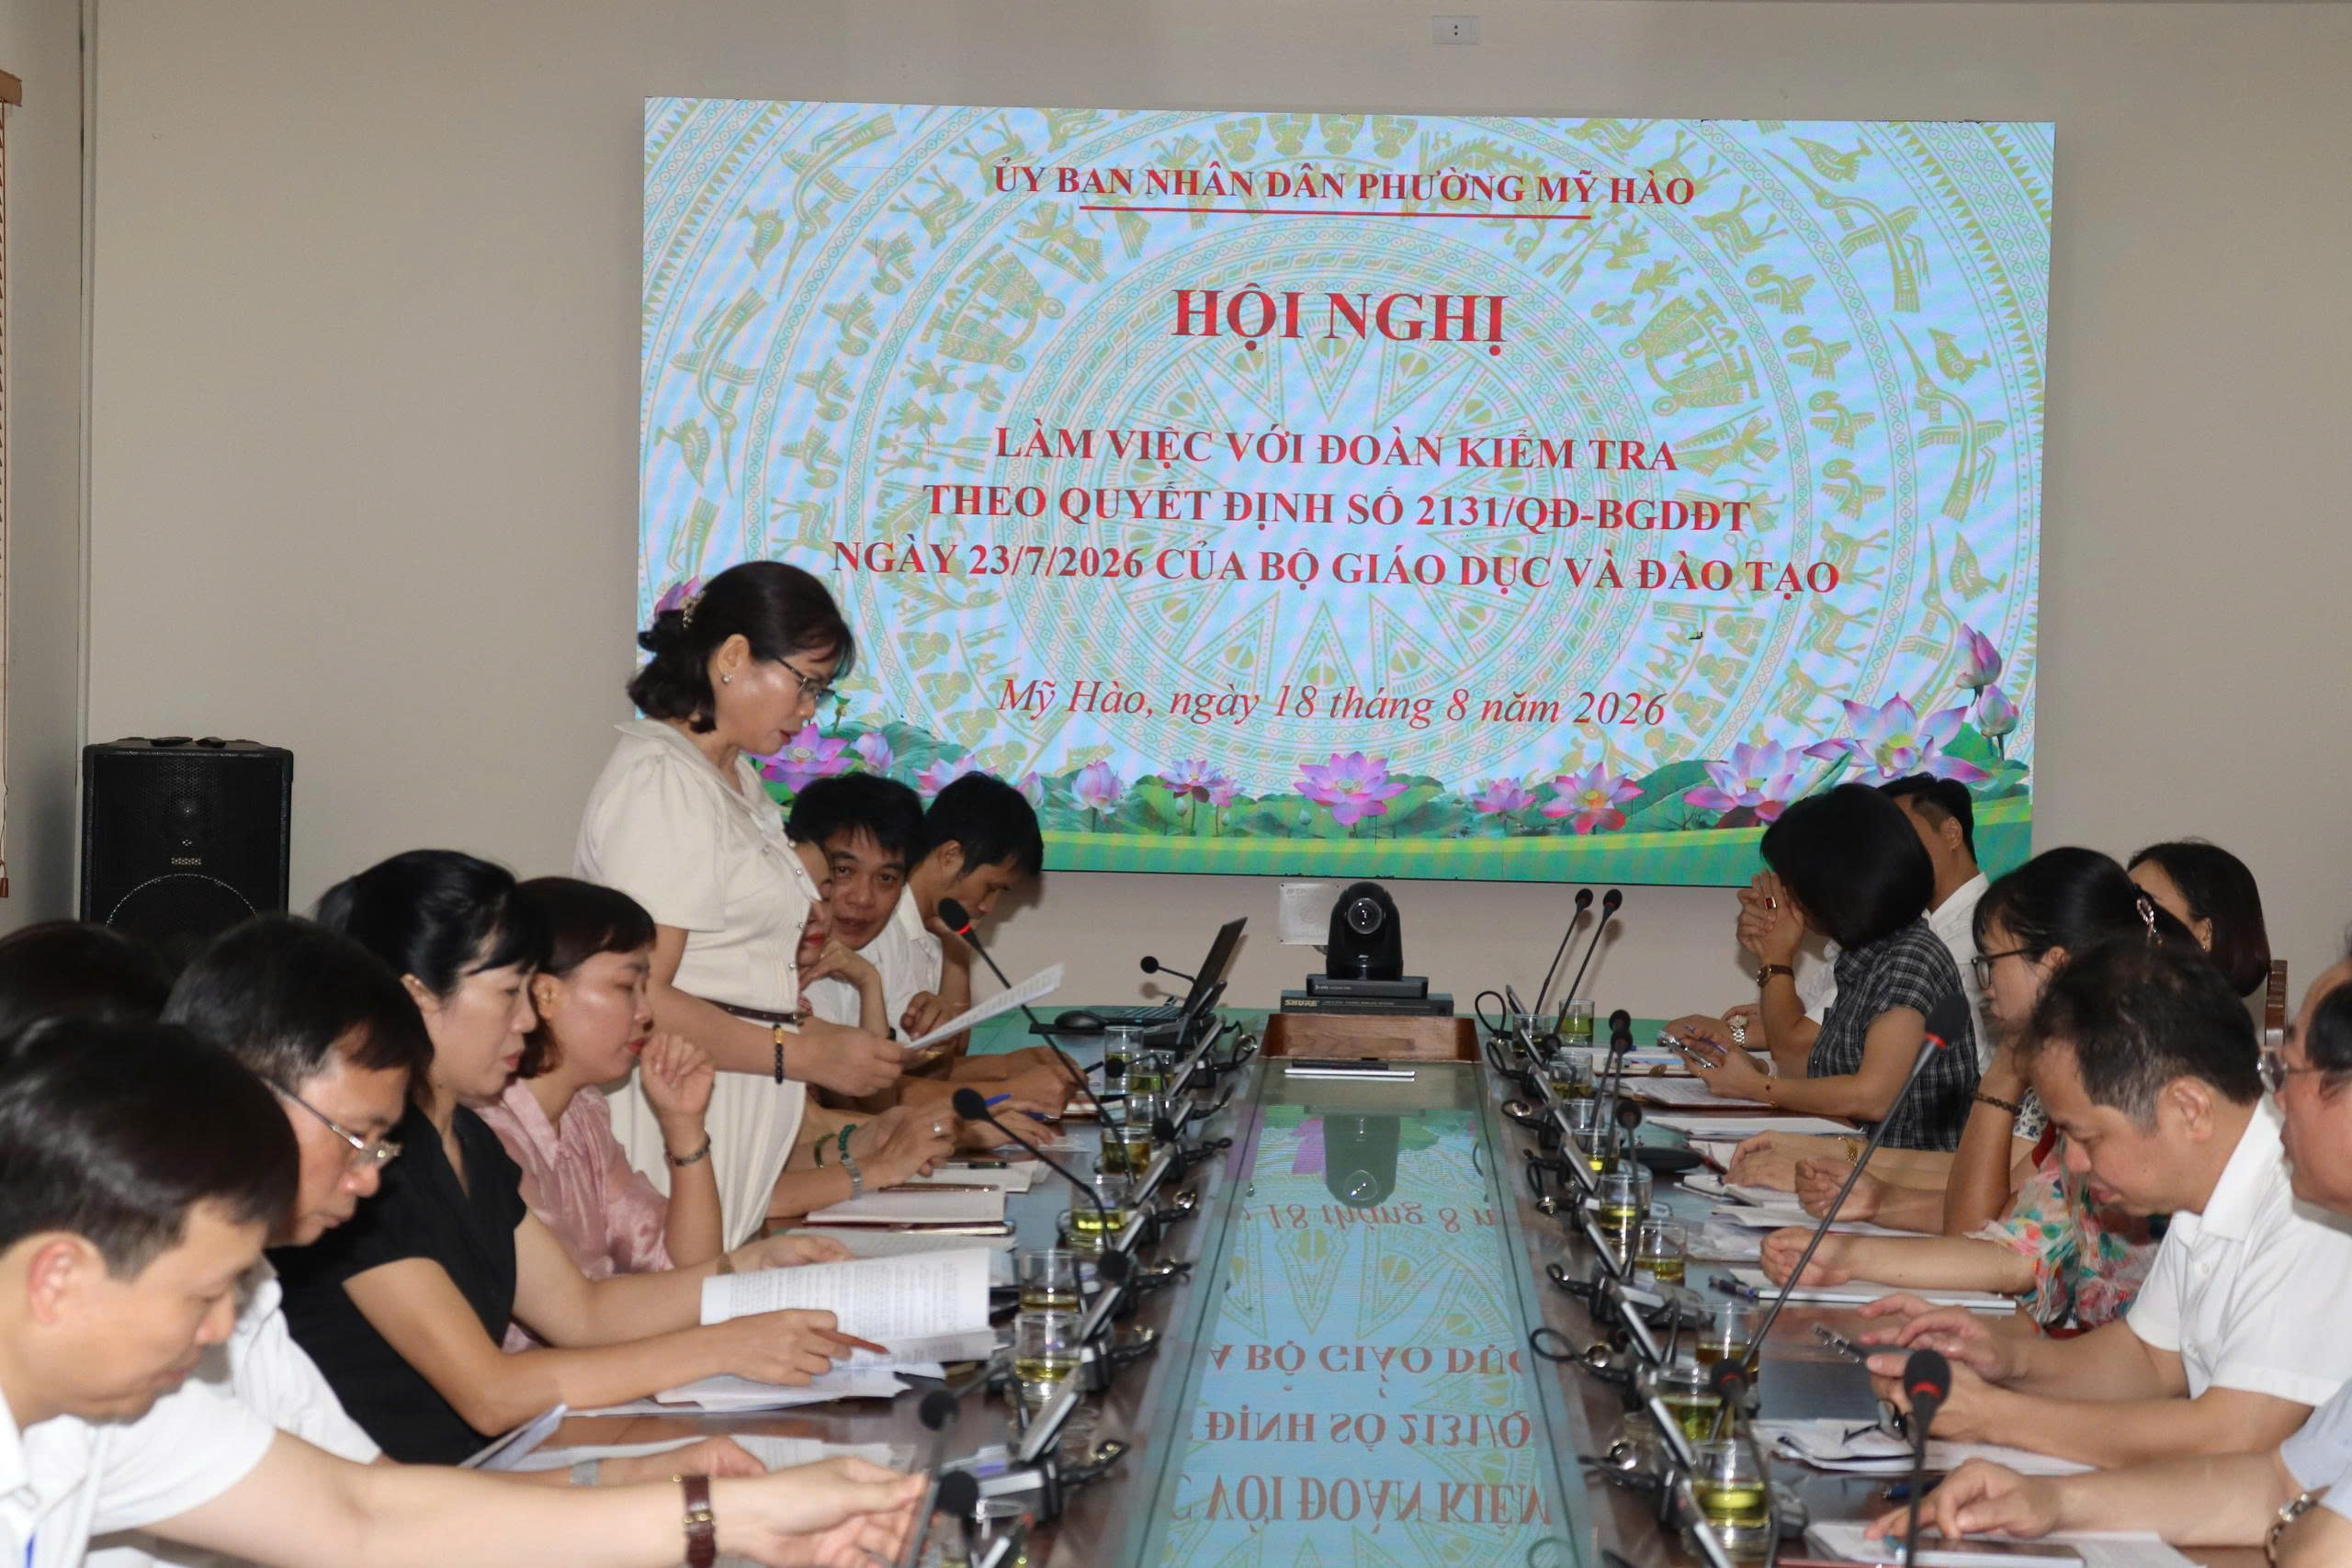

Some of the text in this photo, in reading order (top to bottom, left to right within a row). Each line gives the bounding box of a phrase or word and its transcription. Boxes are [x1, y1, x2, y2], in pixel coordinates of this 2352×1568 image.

[993, 156, 1695, 206] ỦY BAN NHÂN DÂN PHƯỜNG MỸ HÀO
[1172, 283, 1507, 356] HỘI NGHỊ
[995, 419, 1679, 472] LÀM VIỆC VỚI ĐOÀN KIỂM TRA
[922, 481, 1750, 533] THEO QUYẾT ĐỊNH SỐ 2131/QĐ-BGDĐT
[833, 534, 1840, 601] NGÀY 23/7/2026 CỦA BỘ GIÁO DỤC VÀ ĐÀO TẠO
[998, 679, 1668, 728] Mỹ Hào, ngày 18 tháng 8 năm 2026
